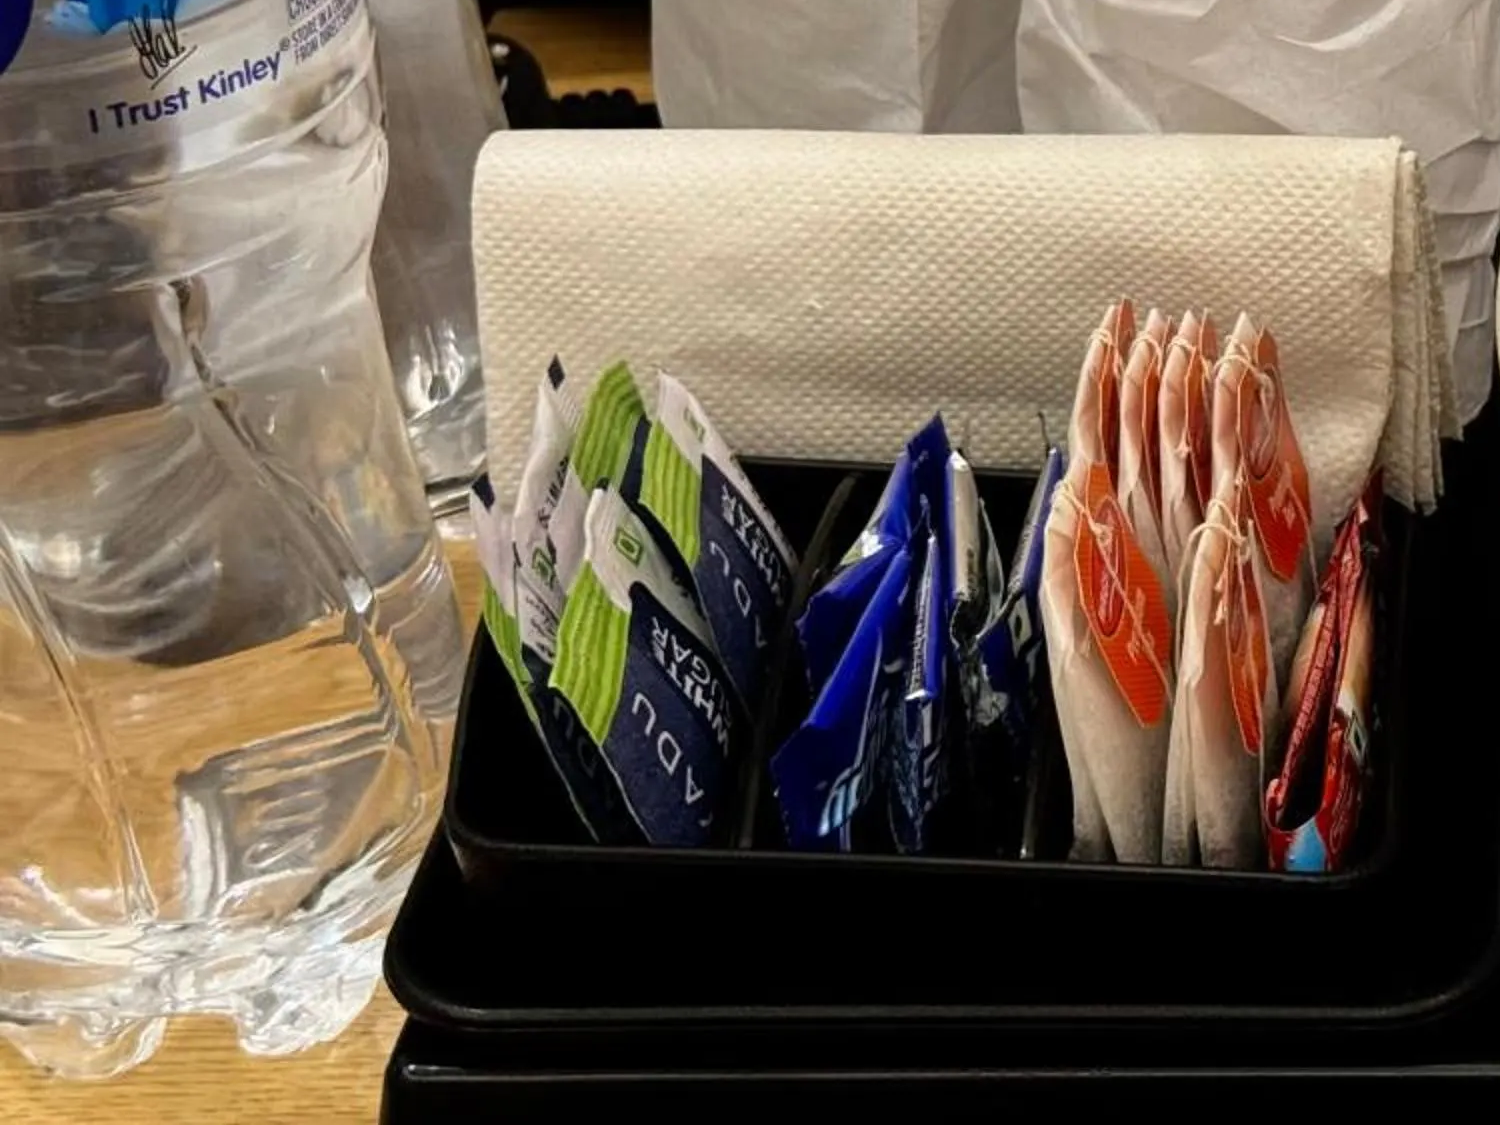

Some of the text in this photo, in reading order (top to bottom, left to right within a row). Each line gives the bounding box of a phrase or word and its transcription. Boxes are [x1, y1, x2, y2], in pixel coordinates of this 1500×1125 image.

[88, 51, 281, 133] I Trust Kinley
[651, 641, 730, 759] WHITE
